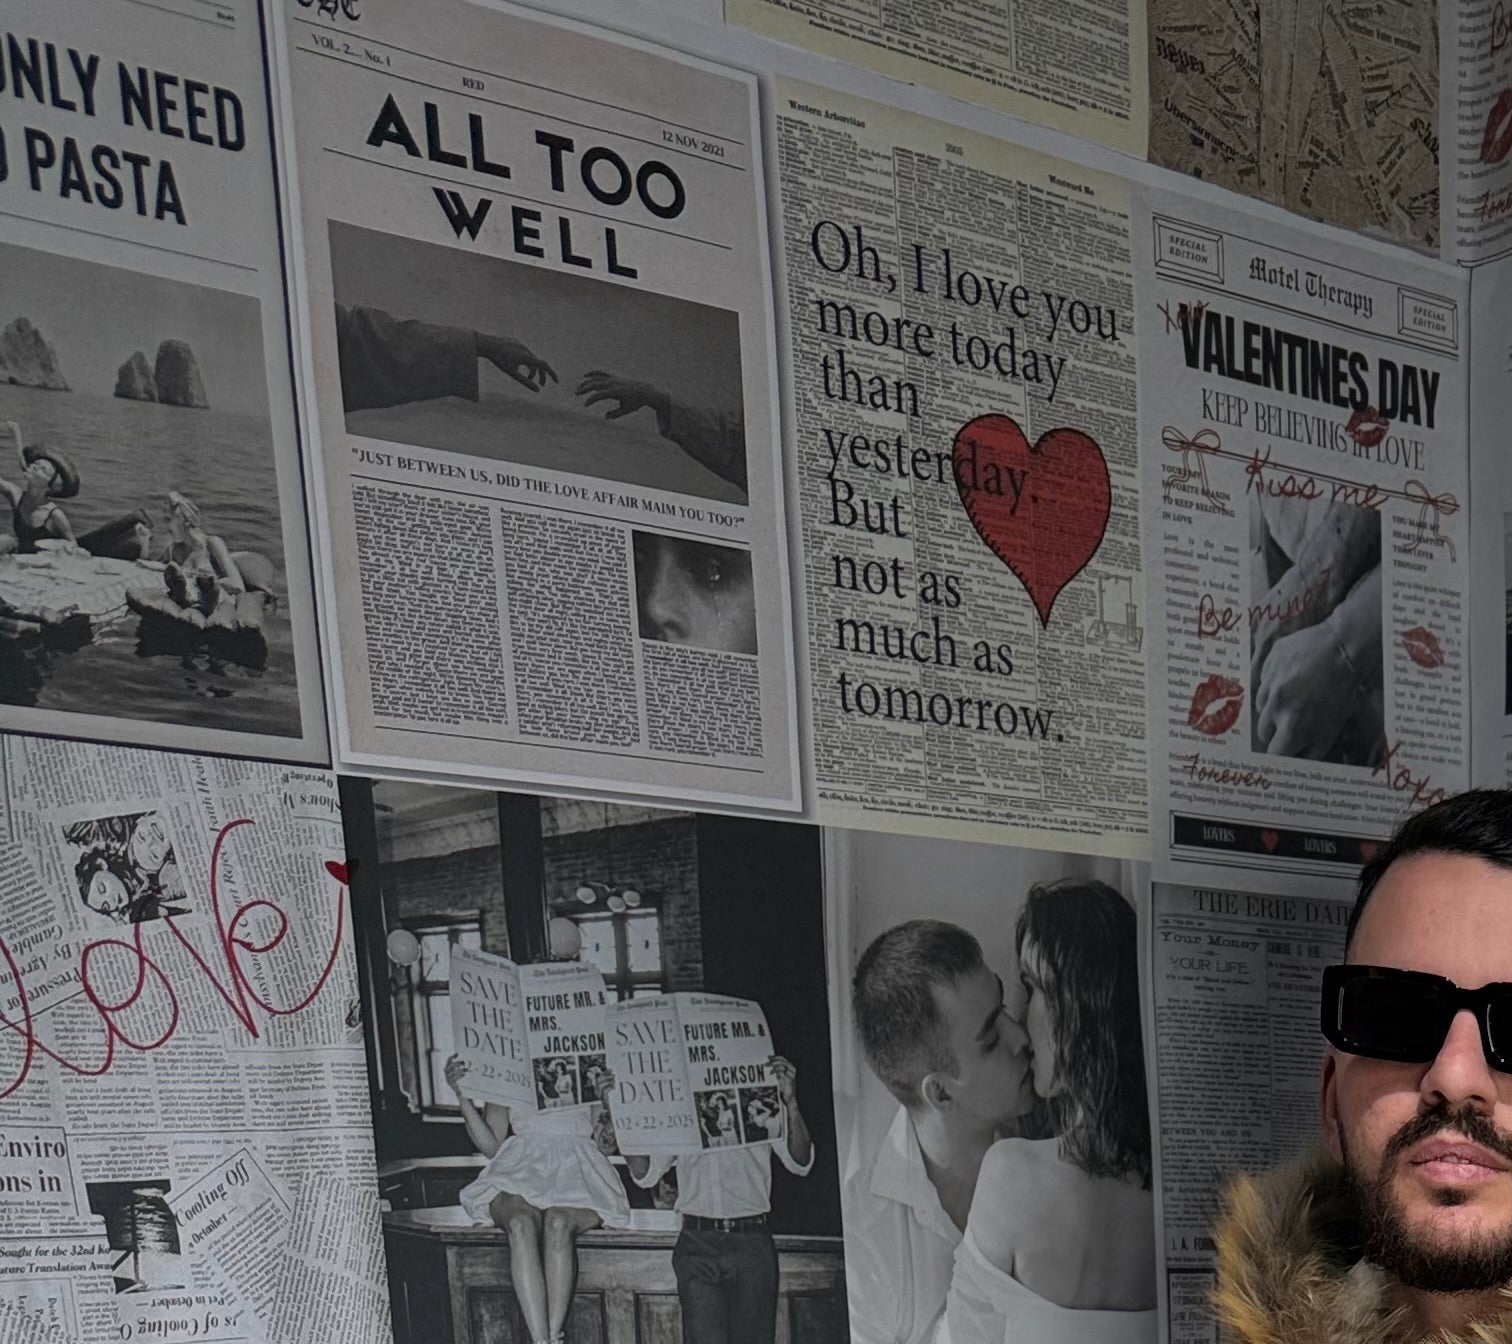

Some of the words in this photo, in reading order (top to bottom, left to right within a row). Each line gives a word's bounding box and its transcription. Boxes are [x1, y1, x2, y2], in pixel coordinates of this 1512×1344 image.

[0, 32, 100, 117] NLY
[118, 61, 246, 152] NEED
[24, 126, 188, 226] PASTA
[366, 94, 511, 179] ALL
[536, 130, 686, 219] TOO
[432, 188, 639, 279] WELL
[812, 220, 897, 293] Oh,
[911, 243, 929, 294] I
[941, 248, 1029, 319] love
[1041, 291, 1120, 343] you
[1248, 256, 1301, 292] Motel
[1305, 271, 1373, 319] Therapy
[816, 299, 934, 358] more
[950, 321, 1067, 403] today
[819, 349, 922, 418] than
[1179, 302, 1370, 413] VALENTINES
[1378, 358, 1441, 430] DAY
[1201, 388, 1249, 428] KEEP
[1254, 401, 1349, 453] BELIEVING
[351, 447, 394, 467] "JUST
[397, 456, 466, 479] BETWEEN
[470, 468, 493, 485] US,
[496, 472, 521, 488] DID
[522, 477, 552, 494] THE
[554, 483, 590, 501] LOVE
[592, 490, 639, 509] AFFAIR
[641, 498, 676, 517] MAIM
[678, 505, 705, 522] YOU
[706, 511, 745, 528] TOO?"
[822, 428, 1039, 516] yesterday.
[829, 478, 907, 538] But
[831, 554, 906, 599] not
[920, 571, 961, 609] as
[835, 616, 961, 668] much
[972, 639, 1014, 676] as
[836, 671, 1065, 743] tomorrow.
[615, 1020, 677, 1046] SAVE
[624, 1050, 672, 1074] THE
[684, 1022, 728, 1040] FUTURE
[732, 1022, 755, 1038] MR.
[758, 1023, 766, 1037] &
[689, 1046, 720, 1063] MRS.
[618, 1079, 684, 1105] DATE
[704, 1064, 765, 1086] JACKSON
[174, 1183, 228, 1227] Cooling
[225, 1158, 250, 1186] Off
